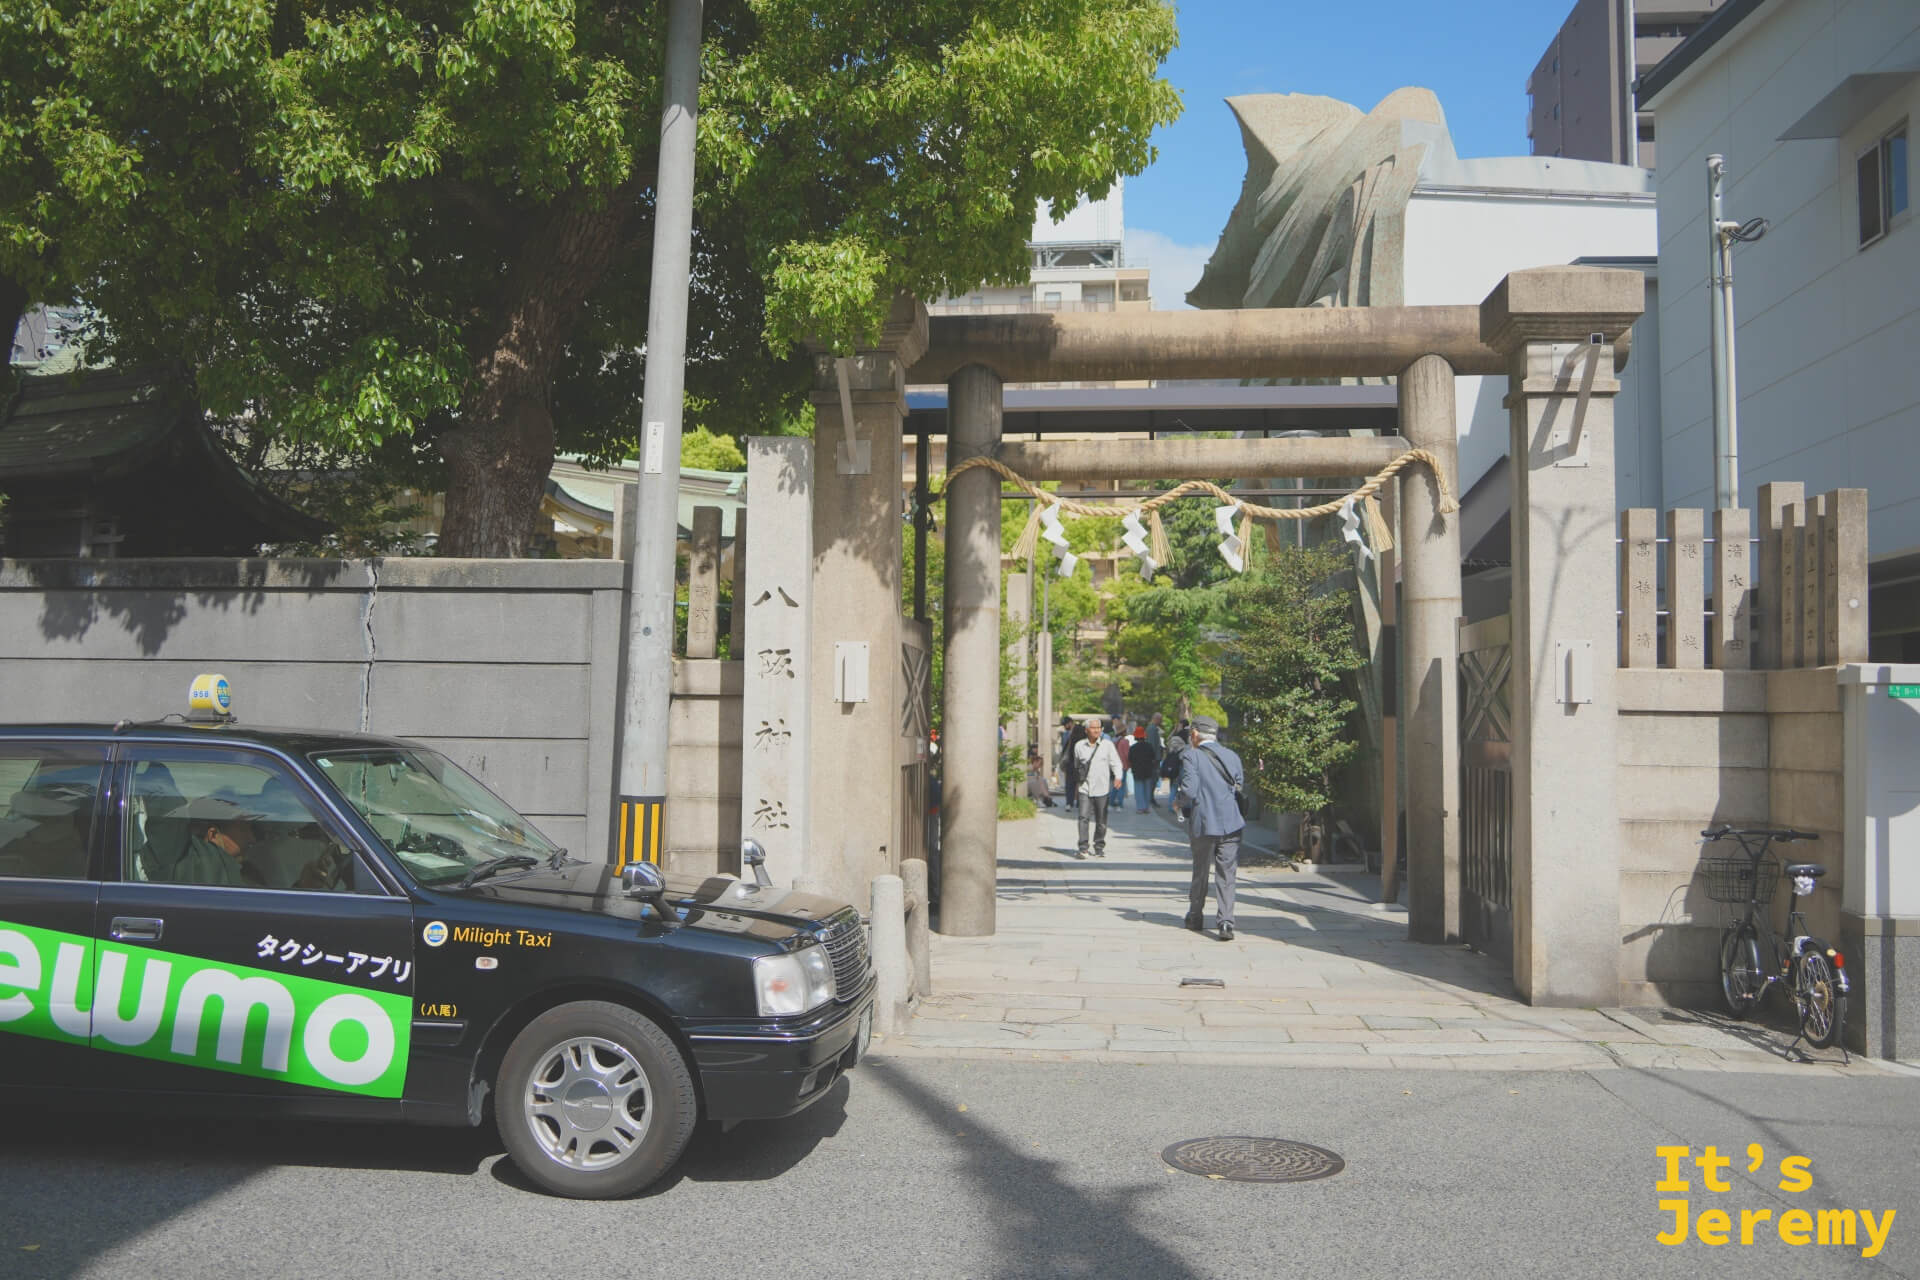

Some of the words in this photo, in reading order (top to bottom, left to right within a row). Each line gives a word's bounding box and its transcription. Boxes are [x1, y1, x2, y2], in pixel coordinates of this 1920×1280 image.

[751, 586, 800, 833] 八阪神社
[256, 933, 412, 984] タクシーアプリ
[453, 926, 512, 948] Milight
[516, 929, 553, 948] Taxi
